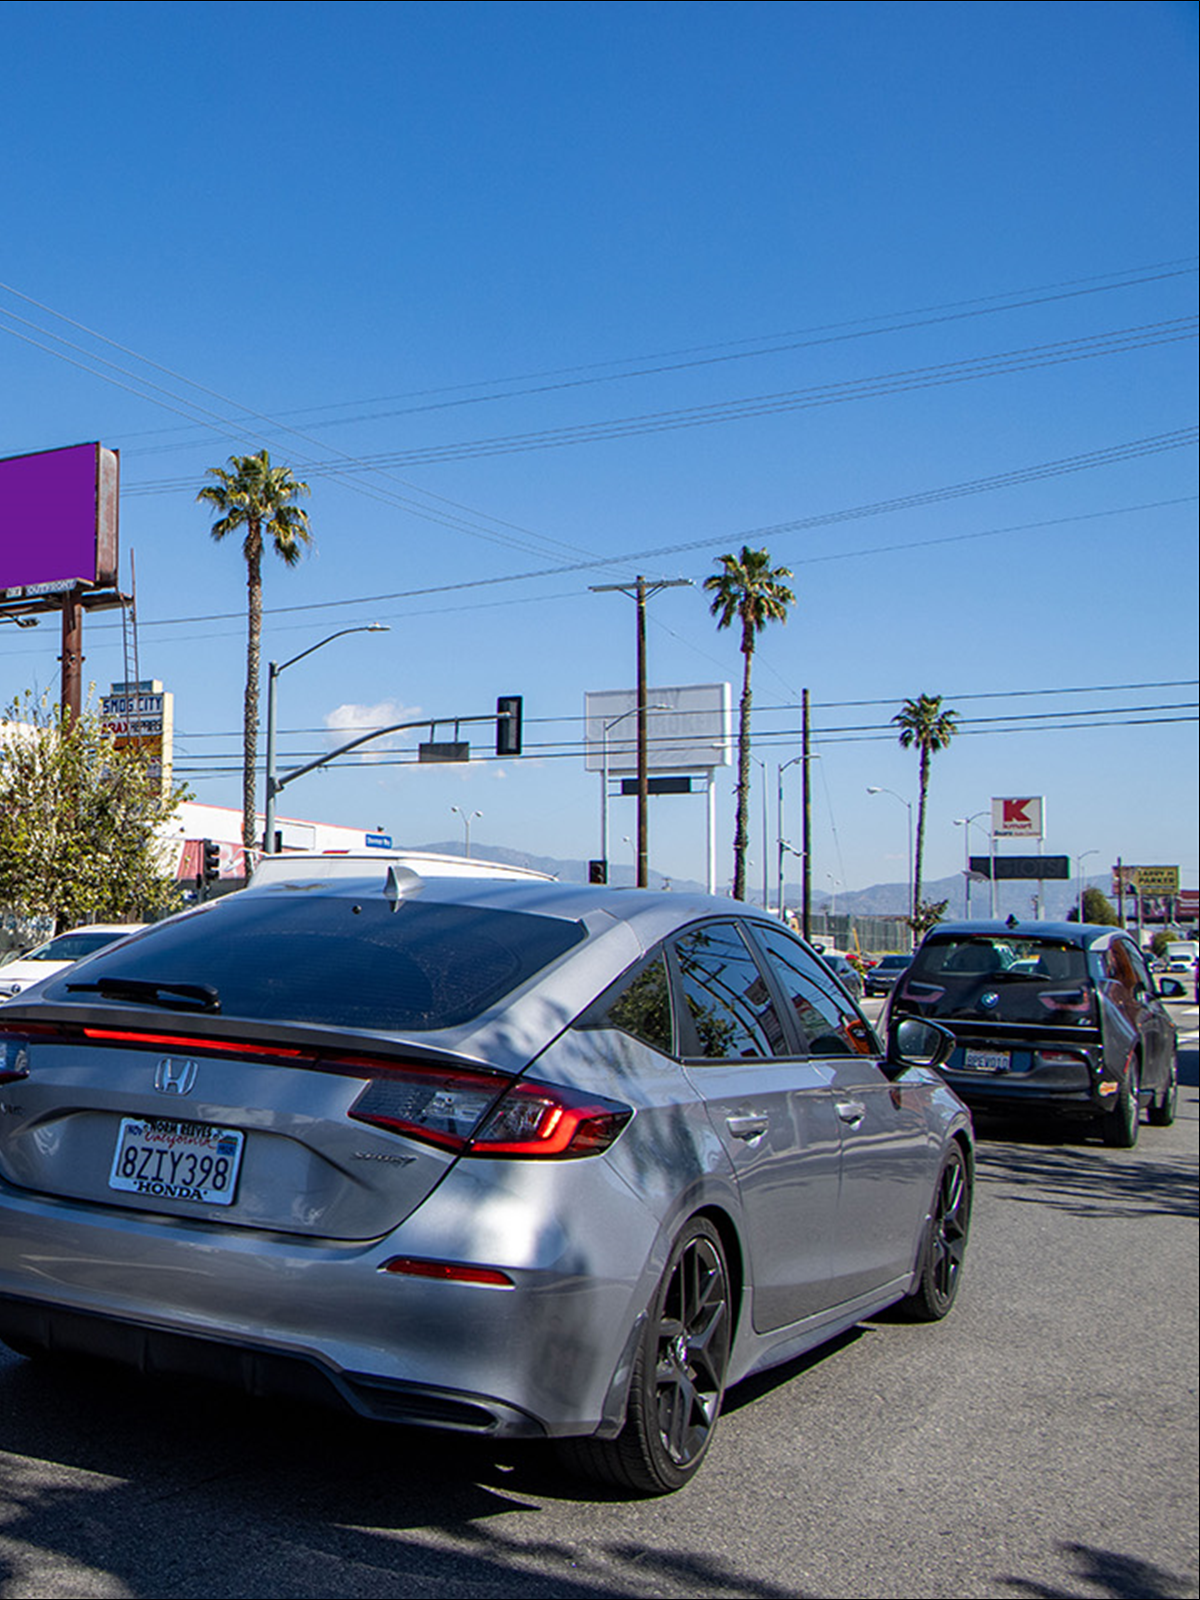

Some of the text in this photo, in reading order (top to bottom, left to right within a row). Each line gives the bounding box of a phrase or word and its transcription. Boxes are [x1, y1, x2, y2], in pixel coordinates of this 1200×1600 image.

[103, 697, 163, 714] SMOG CITY
[144, 1131, 217, 1149] California
[122, 1146, 229, 1190] 8ZIY398
[136, 1180, 203, 1200] HONDA
